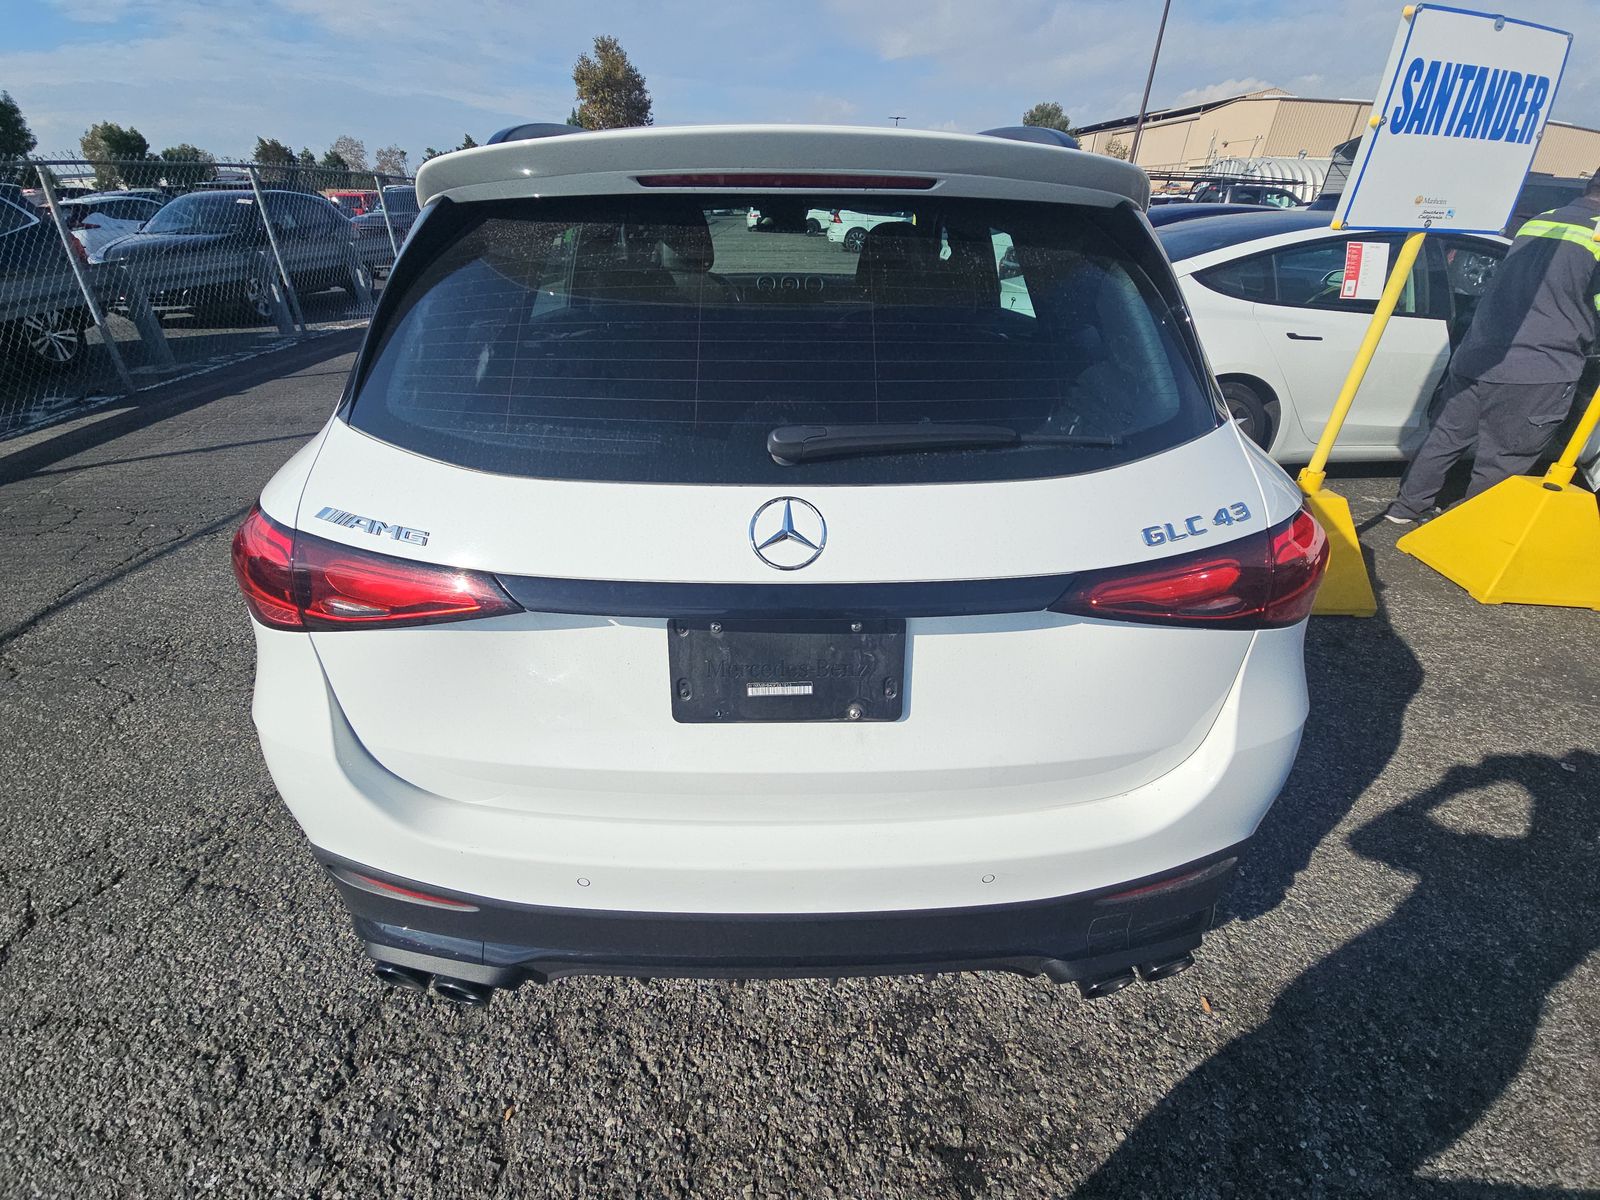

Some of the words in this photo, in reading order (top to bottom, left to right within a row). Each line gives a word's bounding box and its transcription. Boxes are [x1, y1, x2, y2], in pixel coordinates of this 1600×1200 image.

[1389, 57, 1550, 145] SANTANDER
[347, 514, 430, 547] AMG
[1141, 515, 1208, 547] GLC
[1212, 501, 1252, 526] 43
[706, 658, 872, 679] Mercedes-Benz
